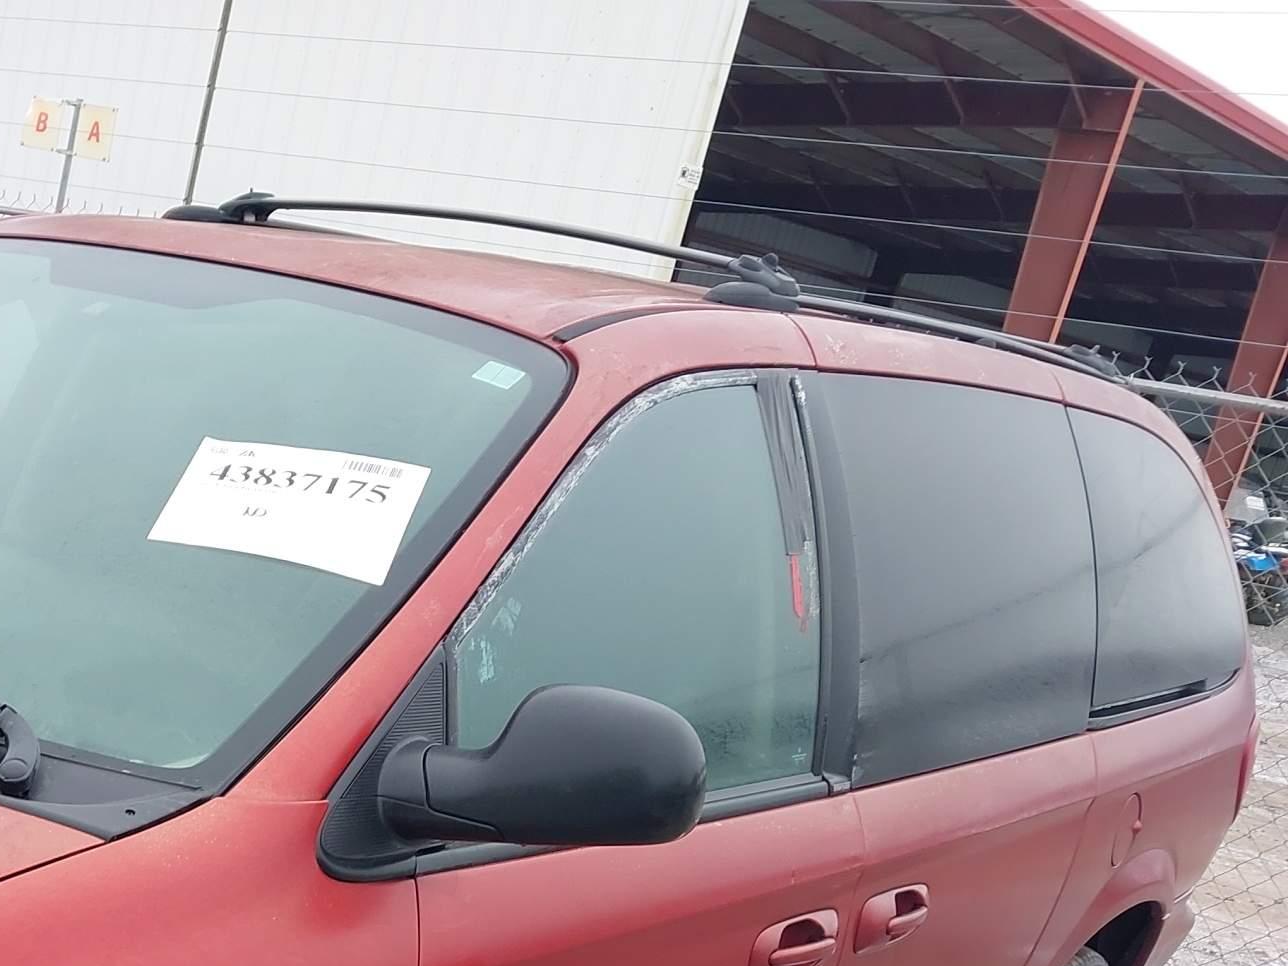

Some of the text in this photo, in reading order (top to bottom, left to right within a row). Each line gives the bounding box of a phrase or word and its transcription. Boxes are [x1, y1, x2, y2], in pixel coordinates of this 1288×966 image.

[35, 111, 49, 133] B
[87, 120, 100, 143] A
[209, 464, 392, 504] 43837175
